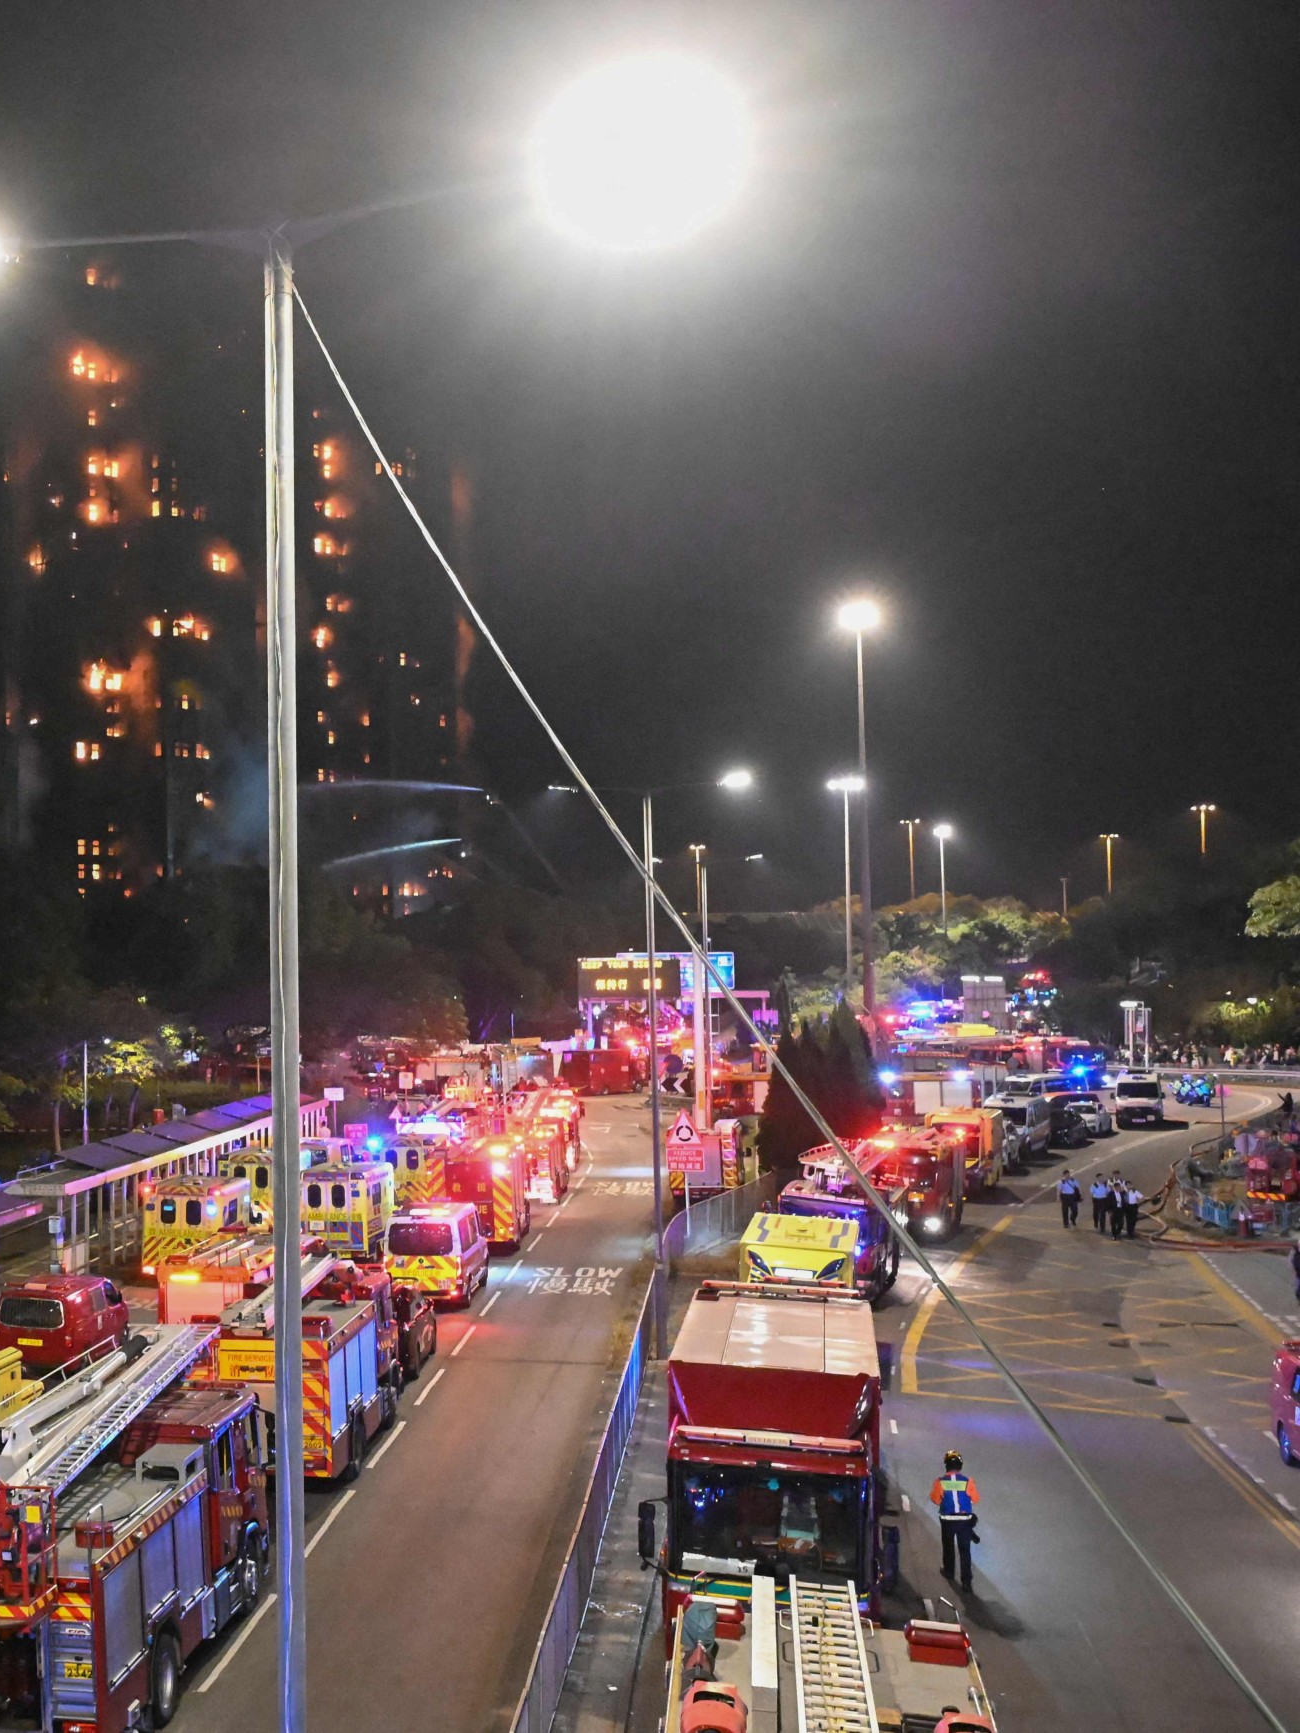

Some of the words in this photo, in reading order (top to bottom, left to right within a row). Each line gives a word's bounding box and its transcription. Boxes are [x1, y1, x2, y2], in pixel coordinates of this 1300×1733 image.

[533, 1267, 624, 1278] SLOW
[525, 1277, 616, 1296] 慢駛
[227, 1354, 242, 1362] FIRE
